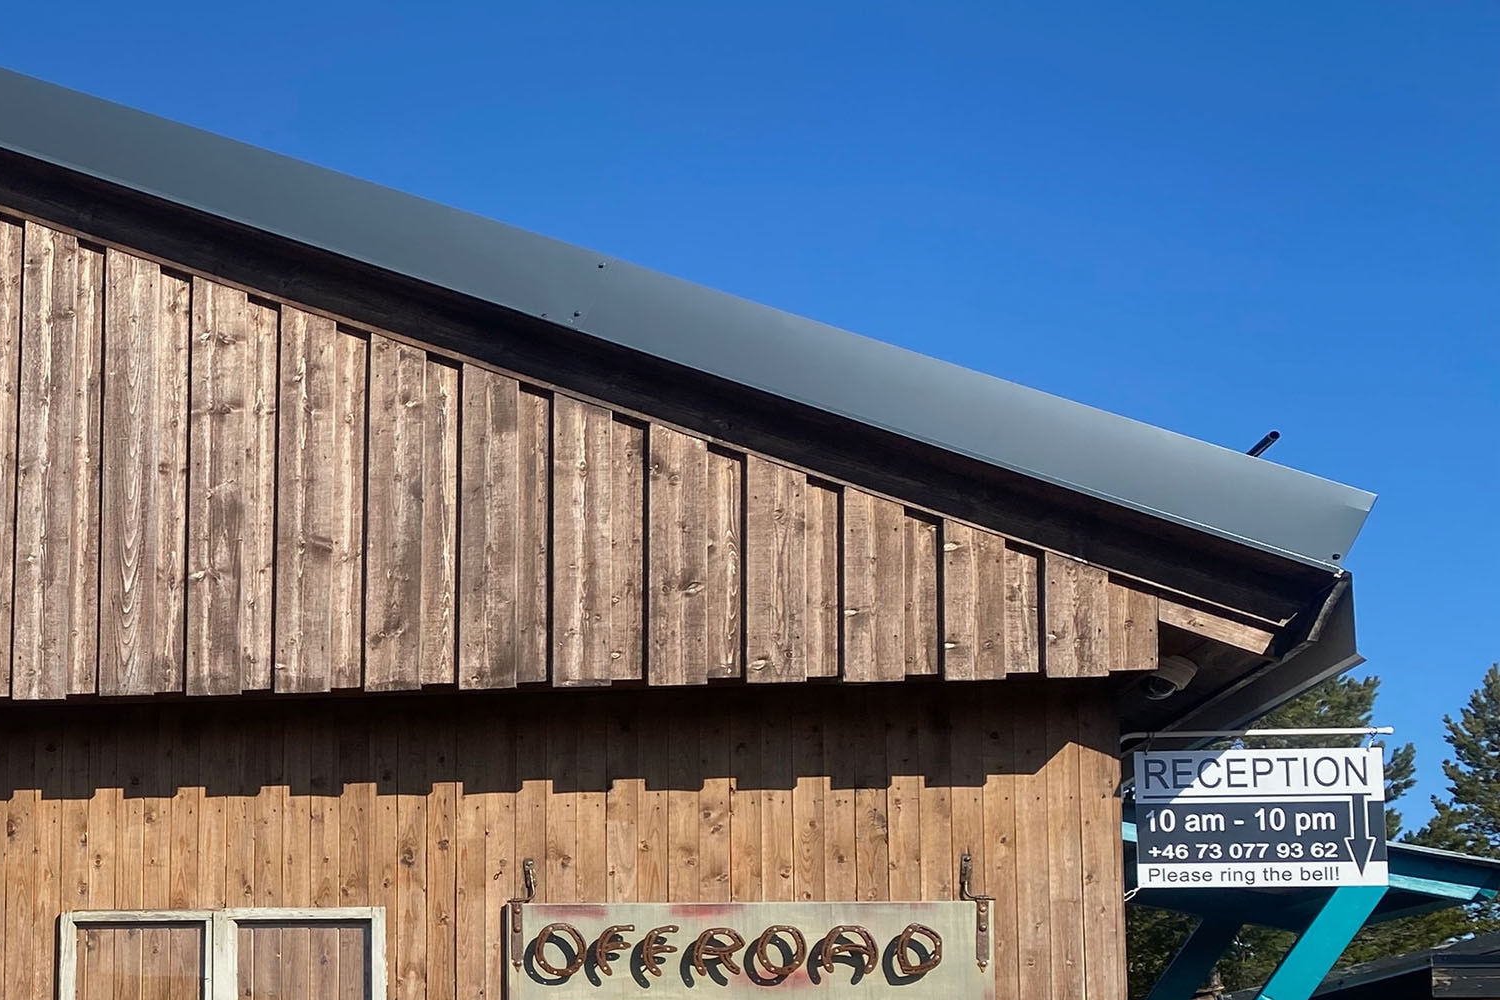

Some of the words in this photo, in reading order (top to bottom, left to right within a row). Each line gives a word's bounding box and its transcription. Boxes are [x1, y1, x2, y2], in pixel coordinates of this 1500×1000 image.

[1143, 756, 1369, 790] RECEPTION
[1146, 808, 1176, 833] 10
[1184, 810, 1225, 833] am
[1254, 807, 1286, 832] 10
[1295, 810, 1337, 836] pm
[1148, 843, 1189, 860] +46
[1196, 843, 1223, 859] 73
[1229, 842, 1270, 859] 077
[1276, 842, 1304, 859] 93
[1310, 841, 1339, 858] 62
[1148, 867, 1213, 883] Please
[1220, 867, 1255, 885] ring
[1262, 867, 1292, 882] the
[1299, 866, 1340, 882] bell!
[532, 922, 945, 980] OFFROAD
